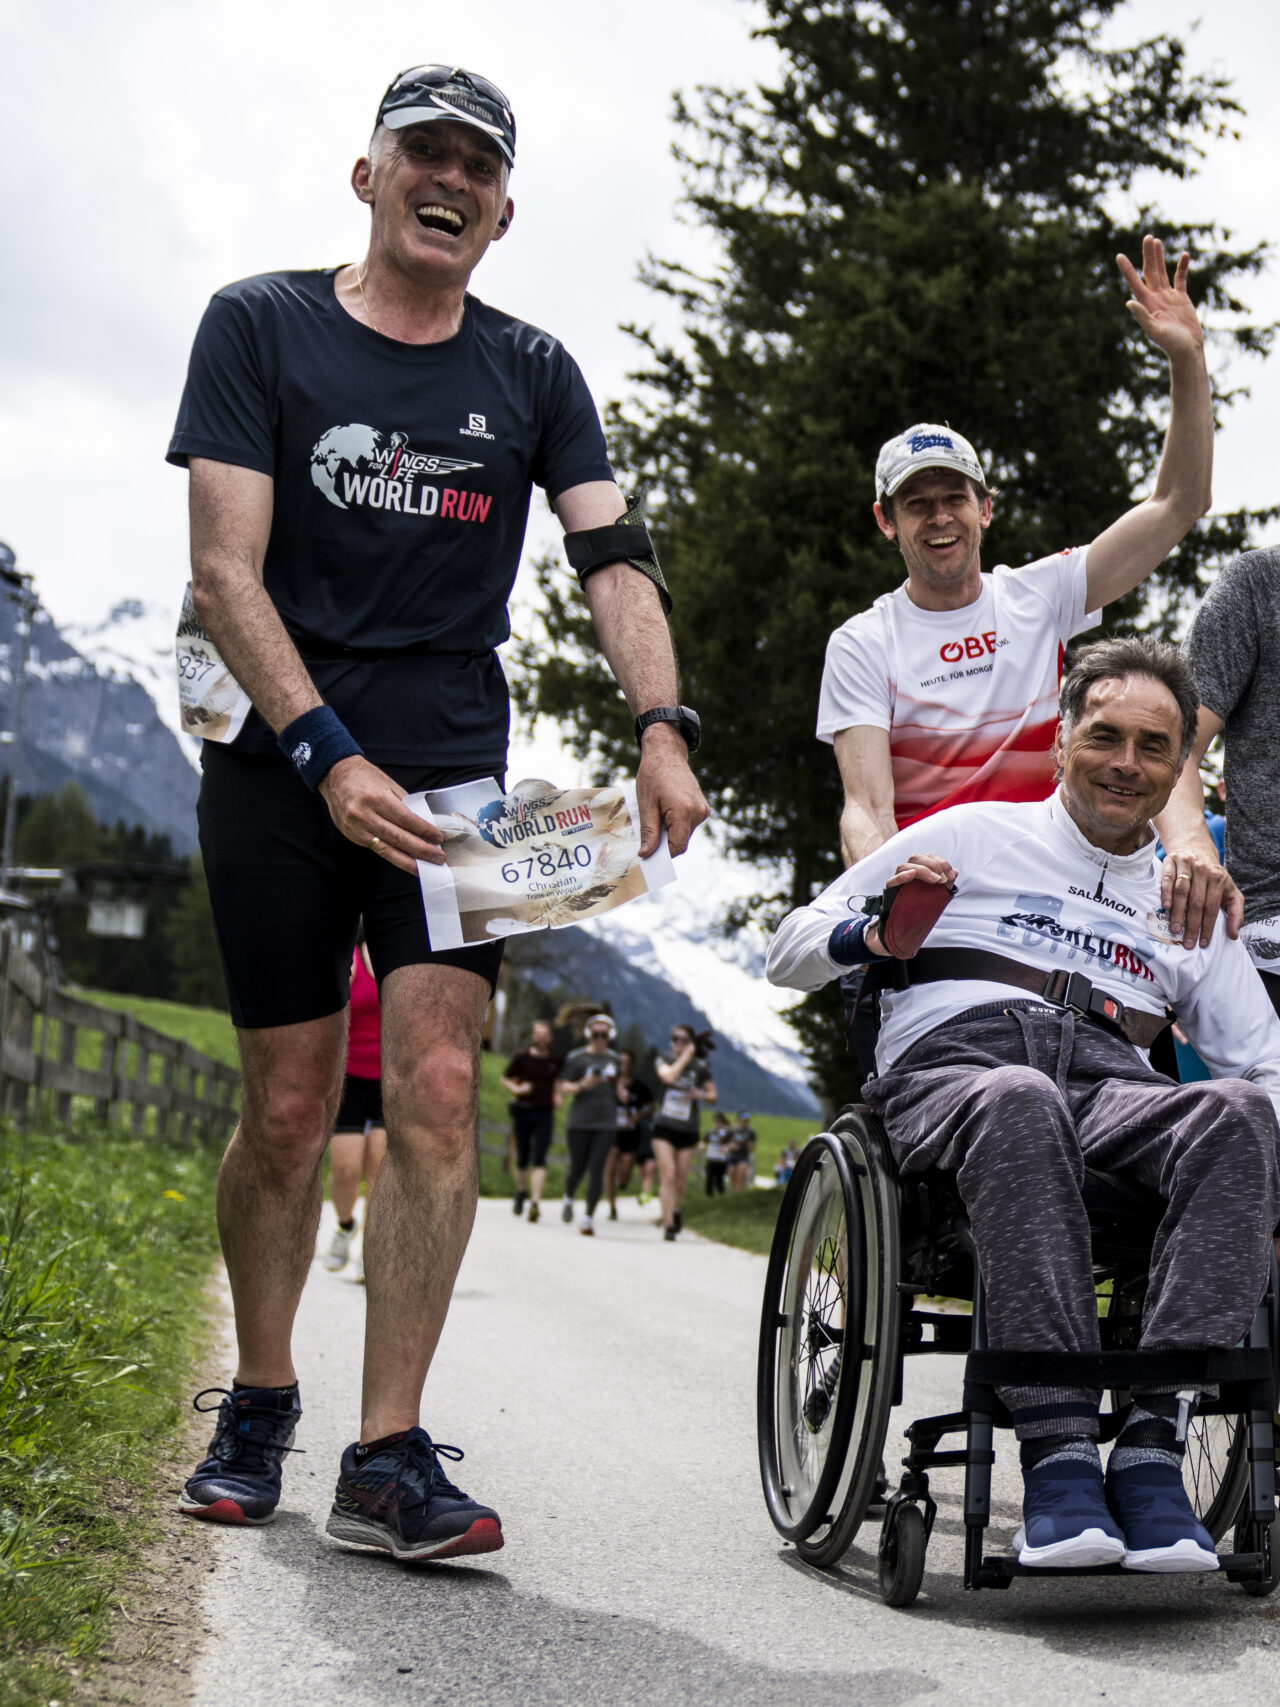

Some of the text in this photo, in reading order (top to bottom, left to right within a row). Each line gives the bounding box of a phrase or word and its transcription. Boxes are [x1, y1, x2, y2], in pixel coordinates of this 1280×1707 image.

[375, 448, 440, 472] WINGS
[368, 461, 418, 483] FOR LIFE
[343, 472, 493, 523] WORLD RUN
[178, 655, 216, 682] 937
[920, 675, 948, 688] HEUTE.
[949, 671, 965, 680] FÜR
[507, 799, 546, 817] WINGS
[516, 810, 537, 824] LIFE
[497, 805, 592, 845] WORLD RUN
[501, 845, 592, 883] 67840
[526, 892, 544, 901] Trins
[556, 883, 584, 897] Wipptal
[528, 876, 577, 892] Christian
[1068, 885, 1138, 918] SALOMON
